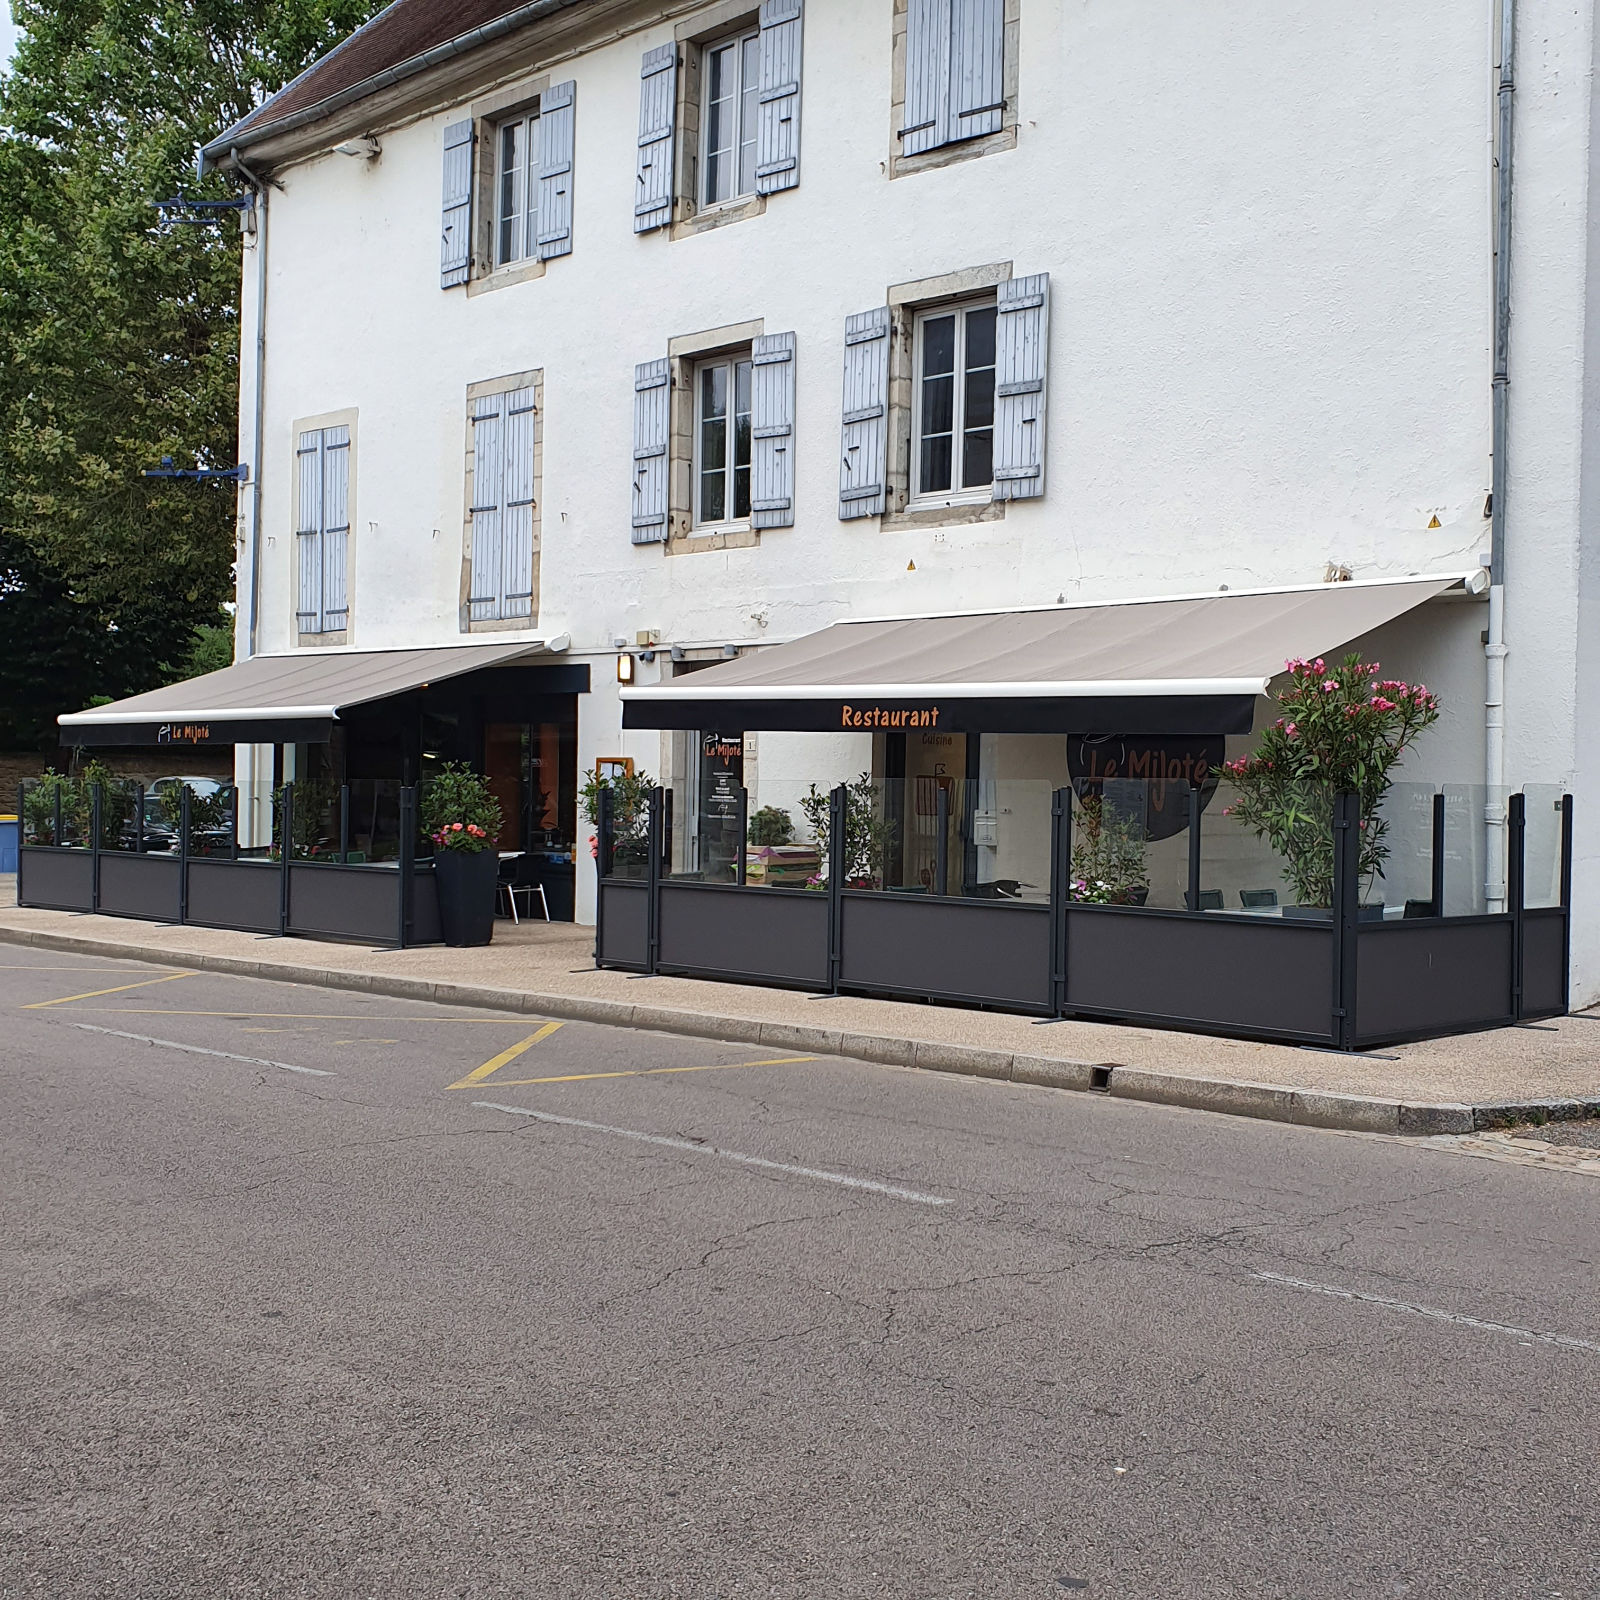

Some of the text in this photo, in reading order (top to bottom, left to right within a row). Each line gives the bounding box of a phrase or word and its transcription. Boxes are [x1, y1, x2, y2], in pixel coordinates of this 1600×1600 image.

[842, 704, 939, 727] Restaurant
[173, 725, 182, 738] Le
[1090, 750, 1119, 782] Le
